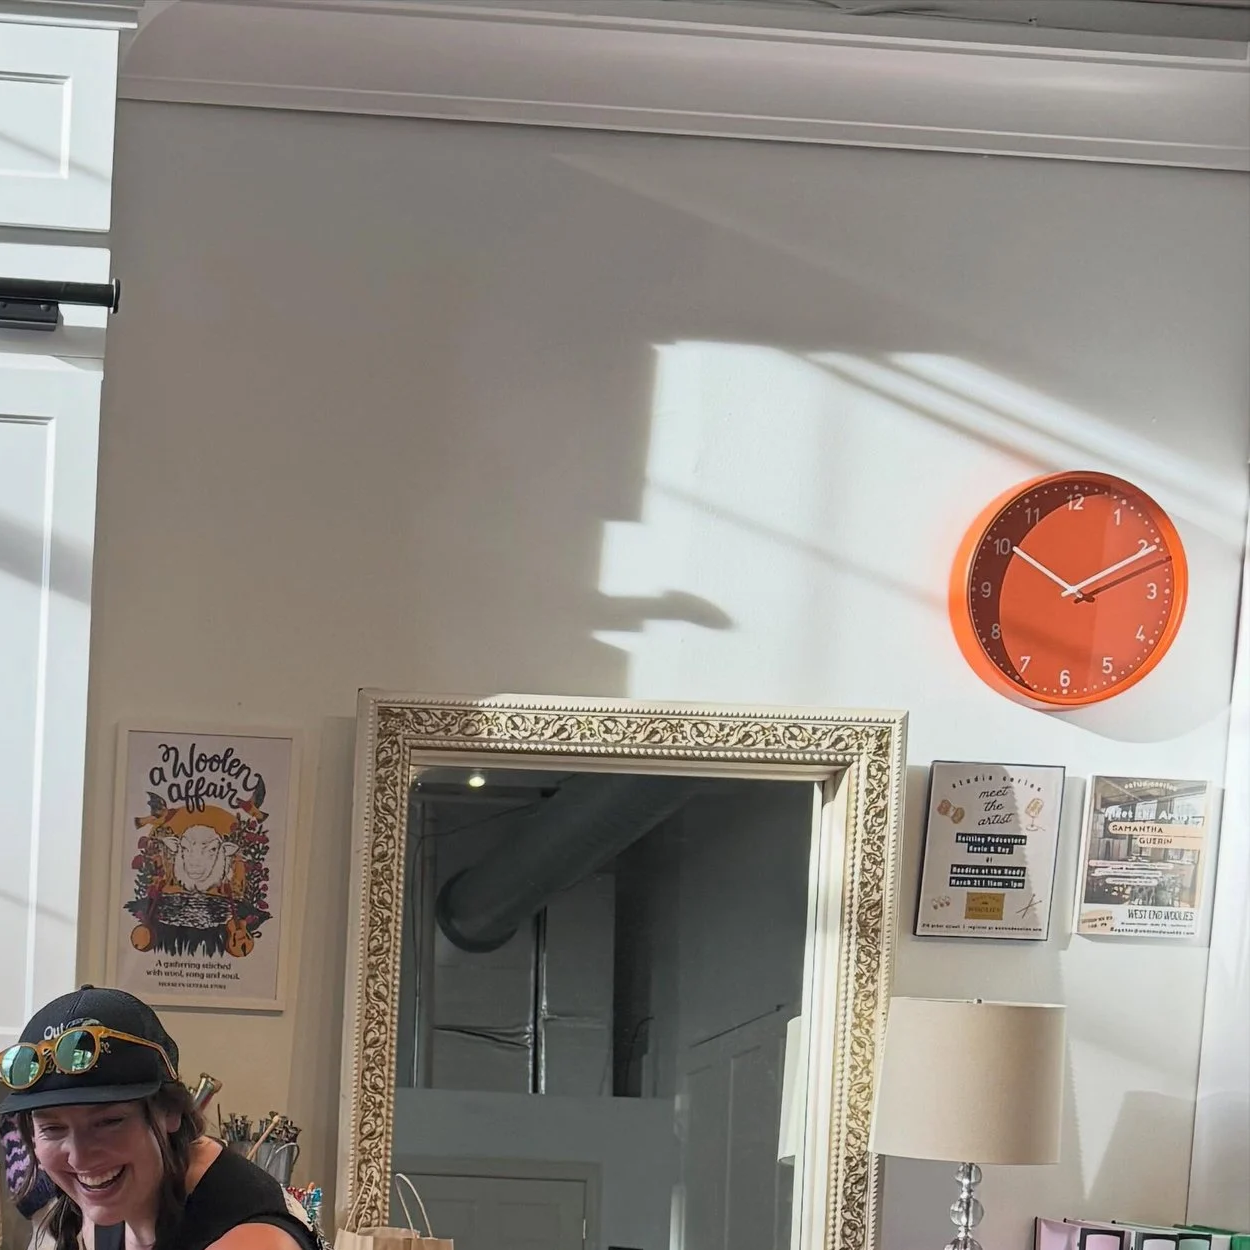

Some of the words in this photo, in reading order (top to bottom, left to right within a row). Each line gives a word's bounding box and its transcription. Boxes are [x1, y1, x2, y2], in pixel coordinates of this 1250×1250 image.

[1066, 494, 1085, 510] 12
[1025, 507, 1041, 524] 11
[1114, 509, 1121, 525] 1
[993, 538, 1011, 555] 10
[981, 581, 991, 598] 9
[1146, 583, 1158, 600] 3
[990, 623, 1001, 640] 8
[1135, 625, 1146, 641] 4
[1019, 656, 1031, 673] 7
[1102, 656, 1114, 674] 5
[1059, 670, 1071, 687] 6
[149, 766, 167, 786] a
[158, 742, 262, 792] Woolen
[167, 776, 241, 814] affair
[978, 785, 1012, 799] meet
[983, 799, 1005, 812] the
[977, 812, 1015, 826] artist
[1111, 824, 1164, 833] SAMANTHA
[1138, 837, 1173, 845] GUERIN
[1128, 908, 1148, 919] WEST
[155, 959, 162, 967] A
